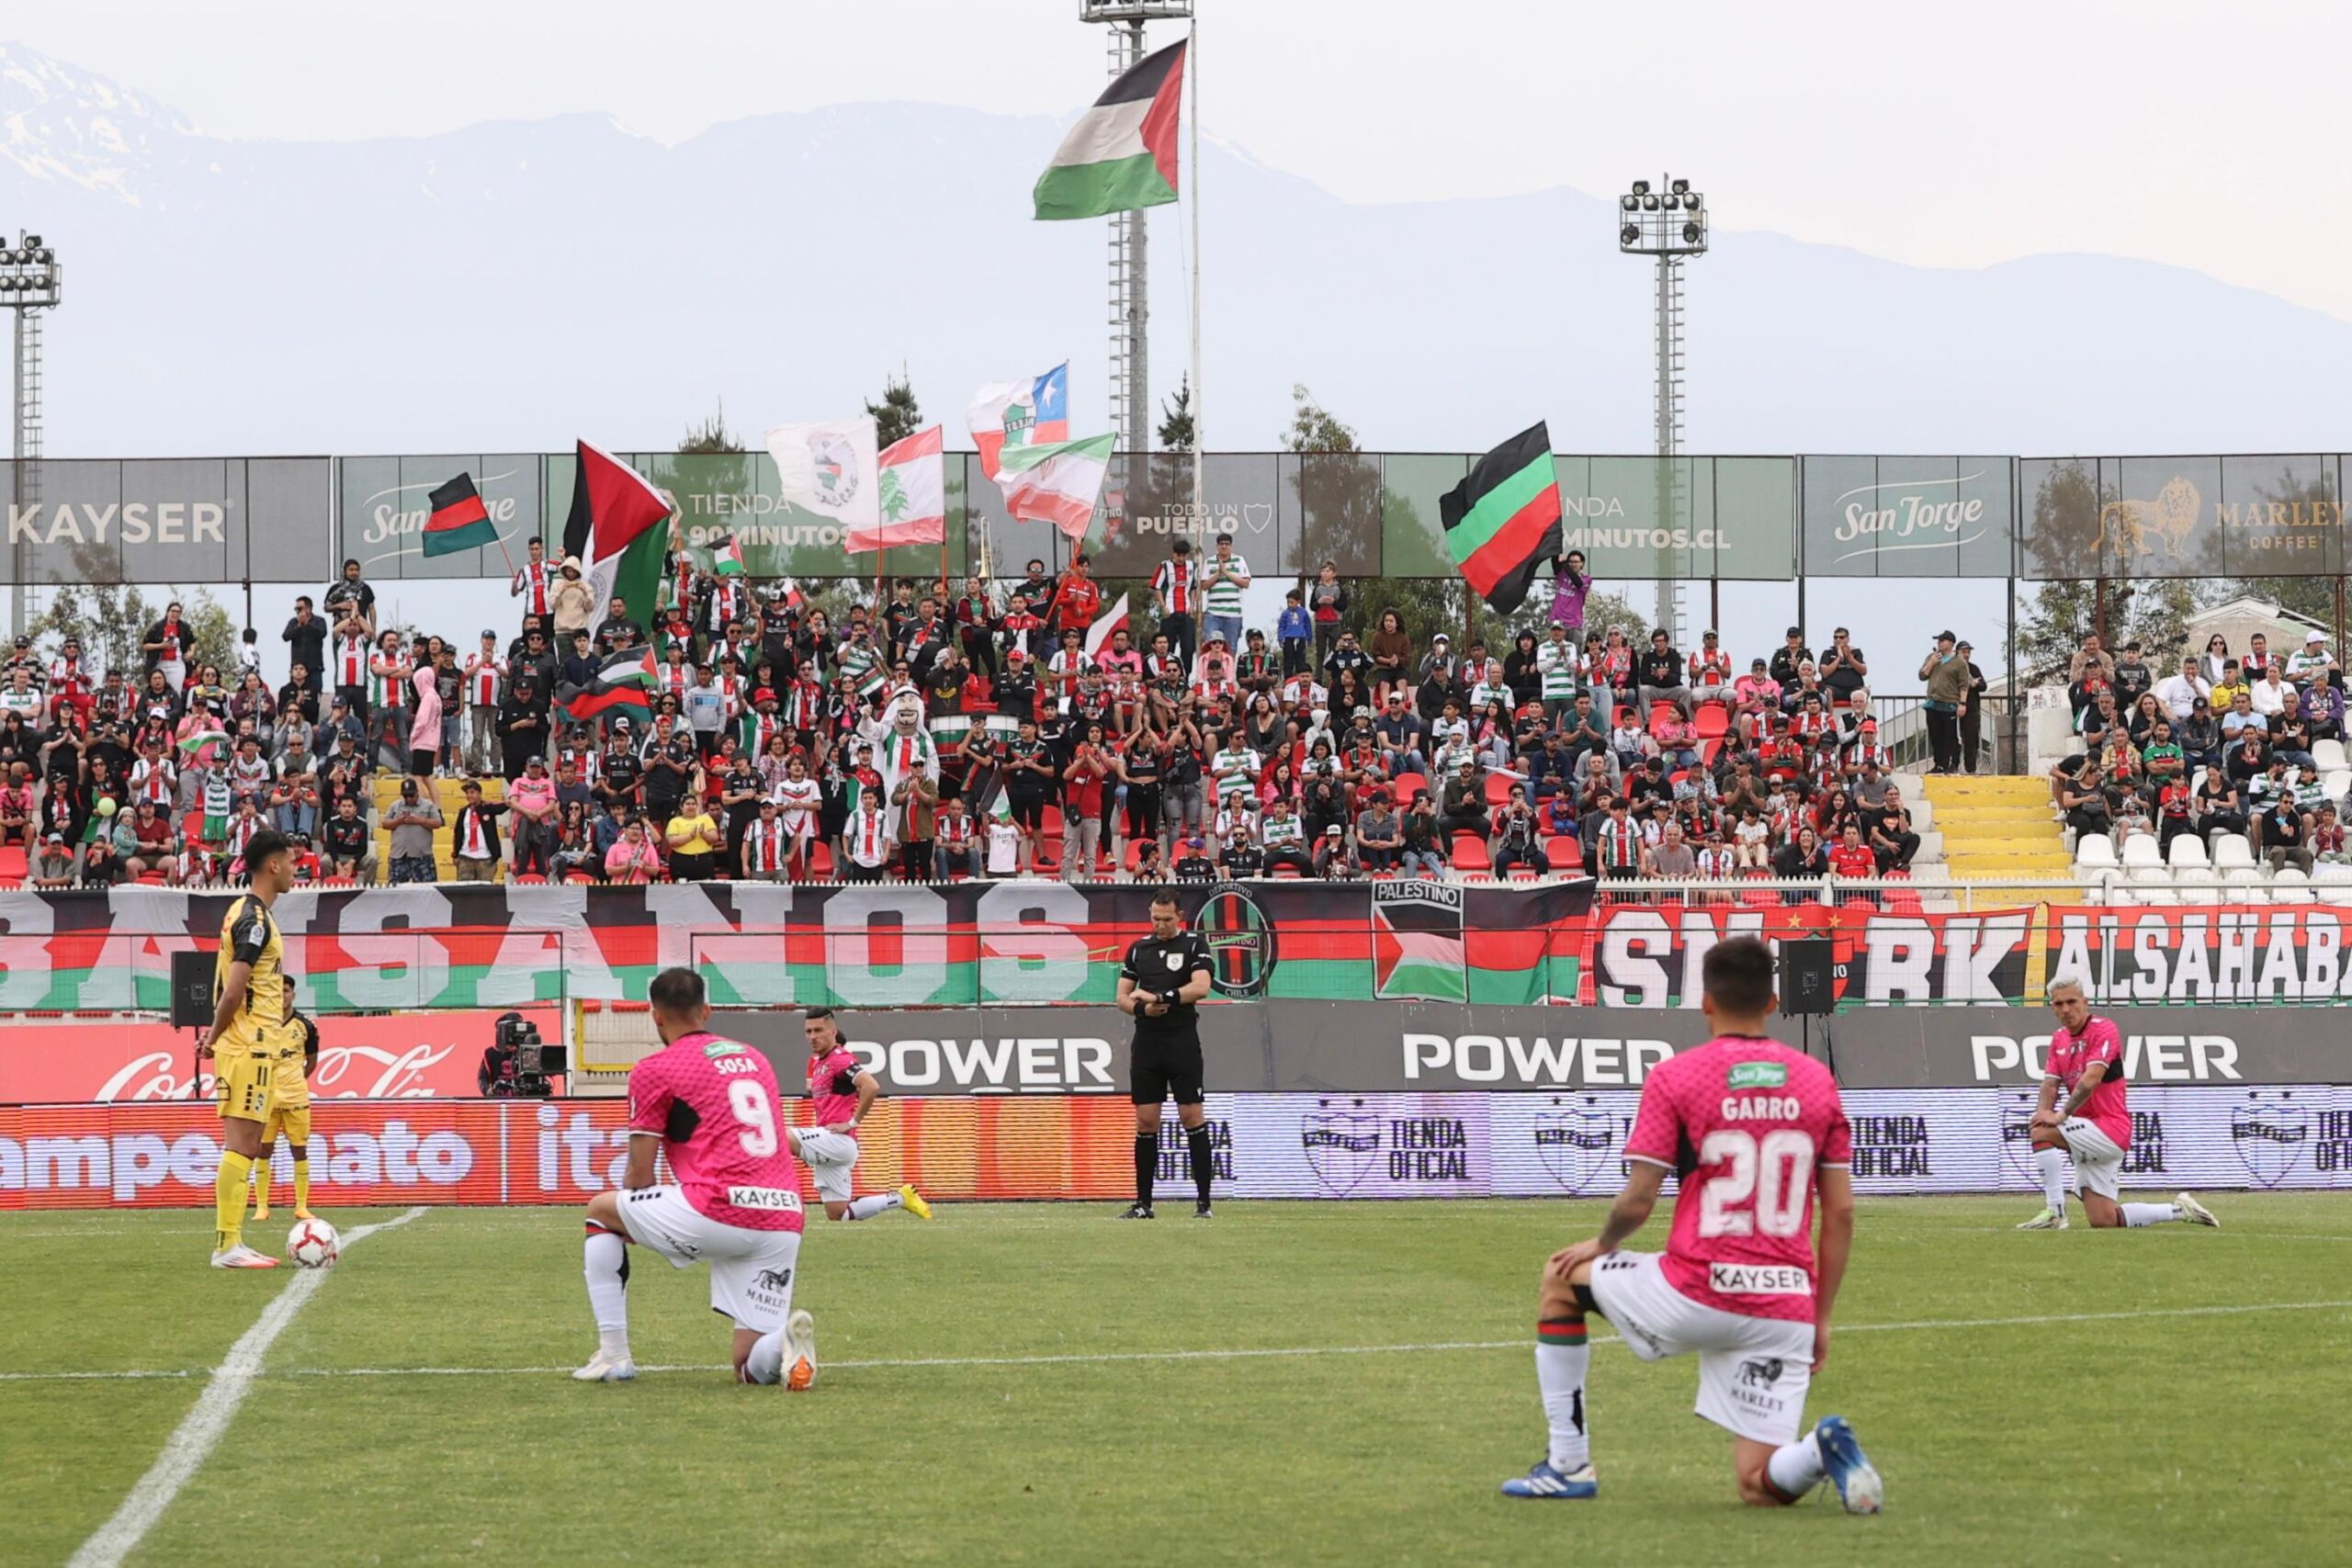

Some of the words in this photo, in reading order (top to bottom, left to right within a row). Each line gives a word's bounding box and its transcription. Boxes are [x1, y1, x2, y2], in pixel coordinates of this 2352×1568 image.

[689, 493, 793, 514] TIENDA
[1162, 503, 1209, 516] TODO
[1215, 503, 1238, 516] UN
[2214, 502, 2351, 527] MARLEY
[7, 502, 226, 544] KAYSER
[1136, 516, 1239, 535] PUEBLO
[1834, 502, 1896, 541] San
[1897, 496, 1984, 536] Jorge
[1562, 527, 1732, 549] MINUTOS.CL
[2249, 536, 2317, 549] COFFEE
[1207, 883, 1252, 898] DEPORTIVO
[1378, 881, 1457, 905] PALESTINO
[1224, 987, 1250, 998] CHILE
[713, 1057, 759, 1075] SOSA
[1402, 1033, 1675, 1085] POWER
[728, 1079, 778, 1158] 9
[1721, 1096, 1801, 1121] GARRO
[1390, 1120, 1468, 1148] TIENDA
[1388, 1151, 1472, 1179] OFICIAL
[1698, 1128, 1816, 1239] 20
[1713, 1267, 1804, 1290] KAYSER
